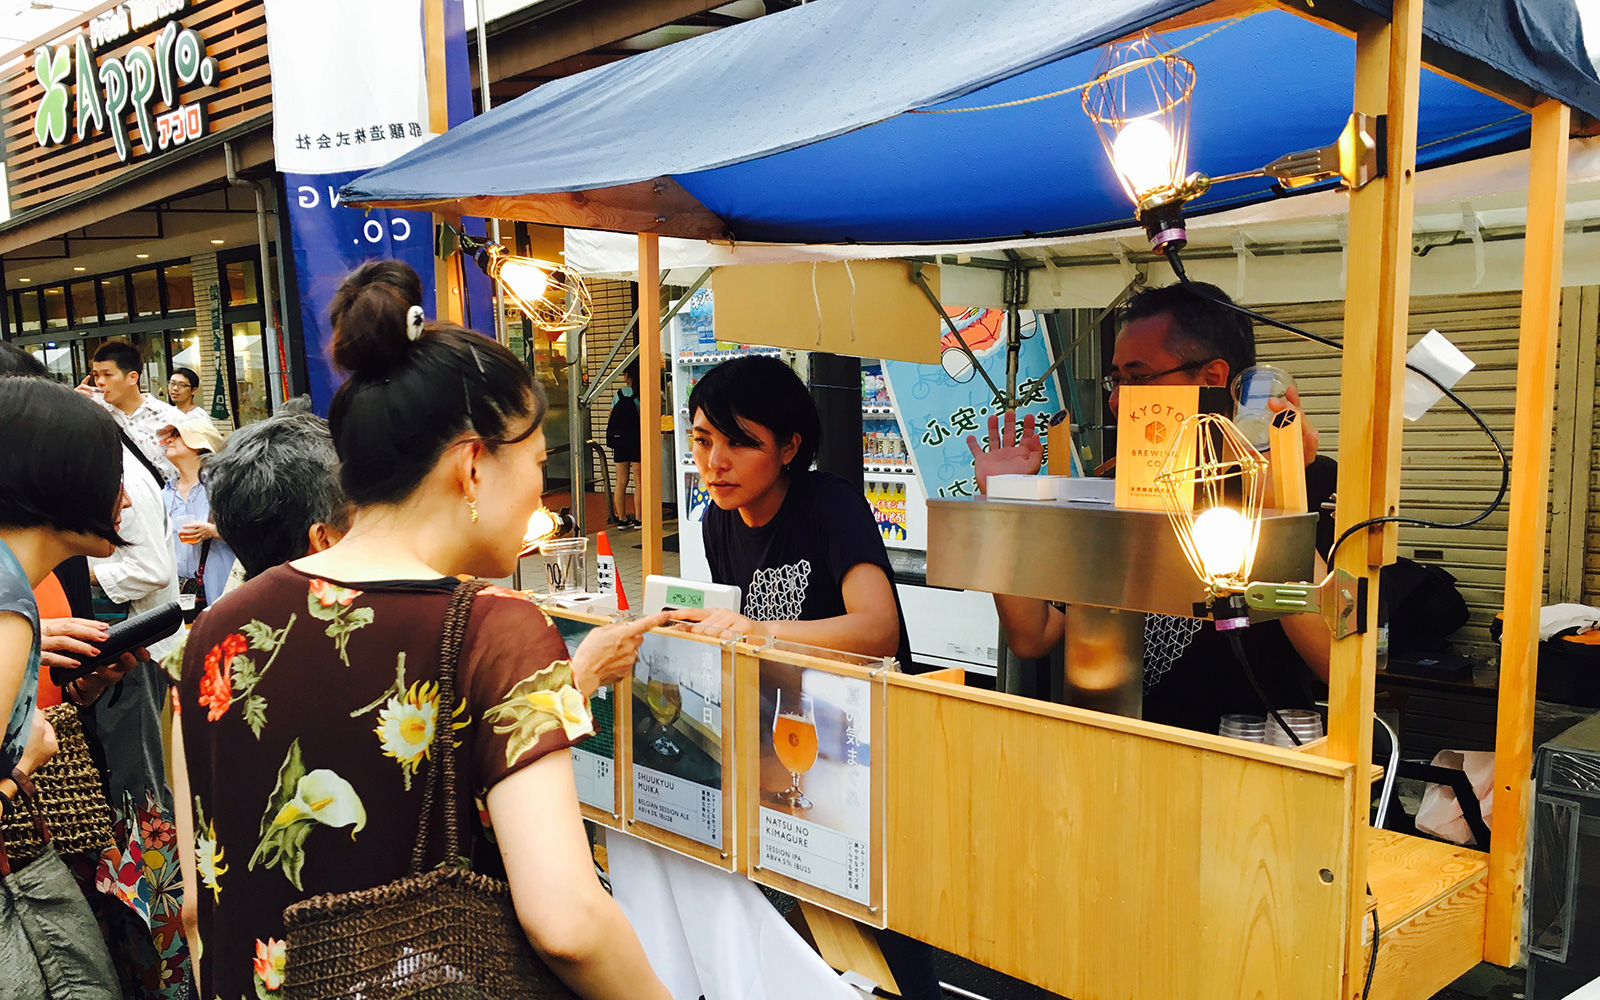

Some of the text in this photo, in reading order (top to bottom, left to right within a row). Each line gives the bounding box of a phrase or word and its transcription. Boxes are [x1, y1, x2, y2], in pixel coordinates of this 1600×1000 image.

[156, 102, 202, 149] アプロ
[1129, 403, 1185, 423] KYOTO
[637, 772, 675, 791] SHUUKYUU
[637, 782, 660, 796] MUIKA
[638, 798, 690, 821] BELGIAN SESSION ALE
[765, 815, 809, 837] NATSU NO
[765, 826, 809, 848] KIMAGURE
[765, 844, 802, 862] SESSION IPA
[765, 853, 812, 874] ABV4.5% IBU25
